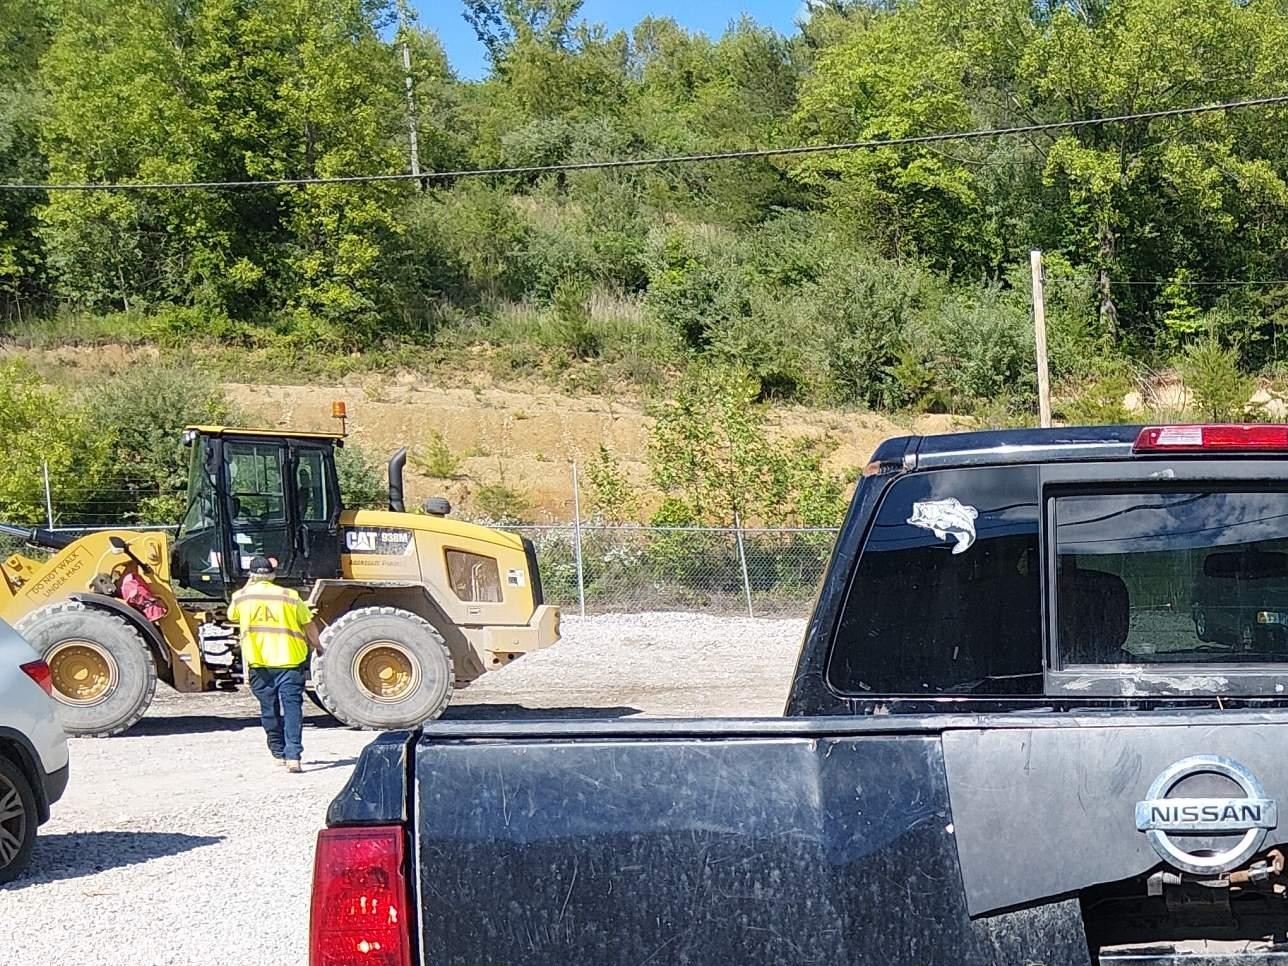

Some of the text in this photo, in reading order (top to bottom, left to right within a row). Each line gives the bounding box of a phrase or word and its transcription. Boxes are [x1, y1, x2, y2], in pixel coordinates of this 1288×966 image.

[346, 531, 377, 550] CAT
[32, 550, 79, 594] DO NOT WALK
[43, 559, 84, 597] UNDER MAST
[1151, 804, 1261, 822] NISSAN
